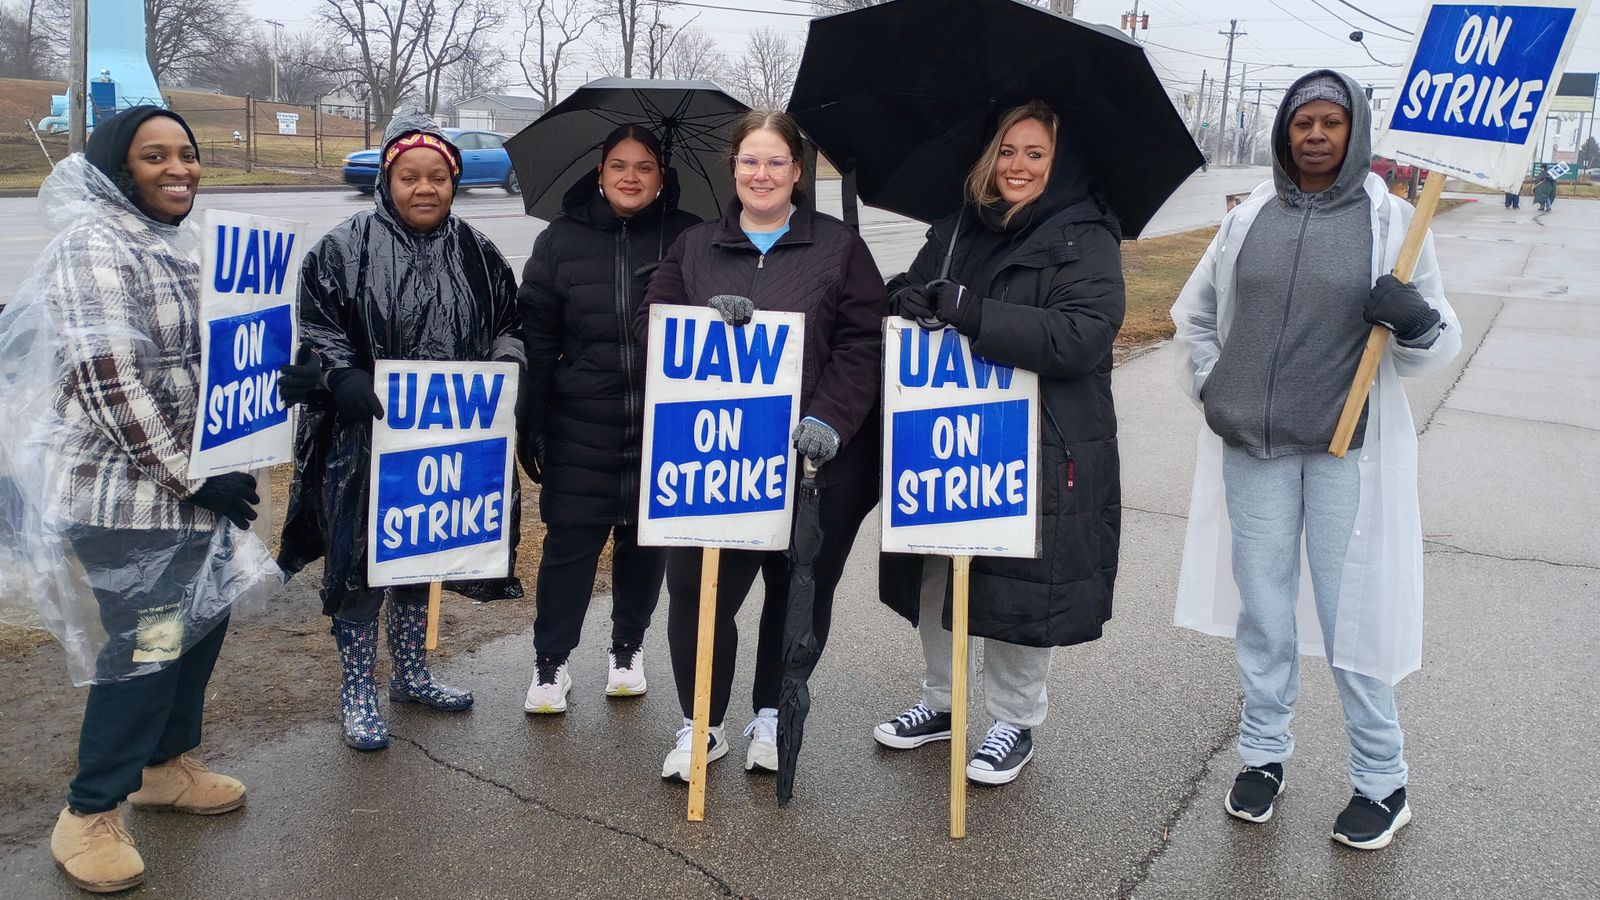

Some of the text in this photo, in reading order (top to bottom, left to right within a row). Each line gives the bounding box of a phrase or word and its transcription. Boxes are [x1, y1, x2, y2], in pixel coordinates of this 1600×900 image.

[1454, 14, 1513, 67] ON
[1402, 69, 1544, 130] STRIKE
[214, 224, 295, 295] UAW
[234, 320, 266, 371] ON
[662, 317, 789, 385] UAW
[386, 372, 505, 430] UAW
[693, 407, 743, 453] ON
[932, 413, 980, 460] ON
[417, 451, 463, 496] ON
[655, 455, 786, 507] STRIKE
[897, 459, 1026, 515] STRIKE
[382, 490, 502, 550] STRIKE
